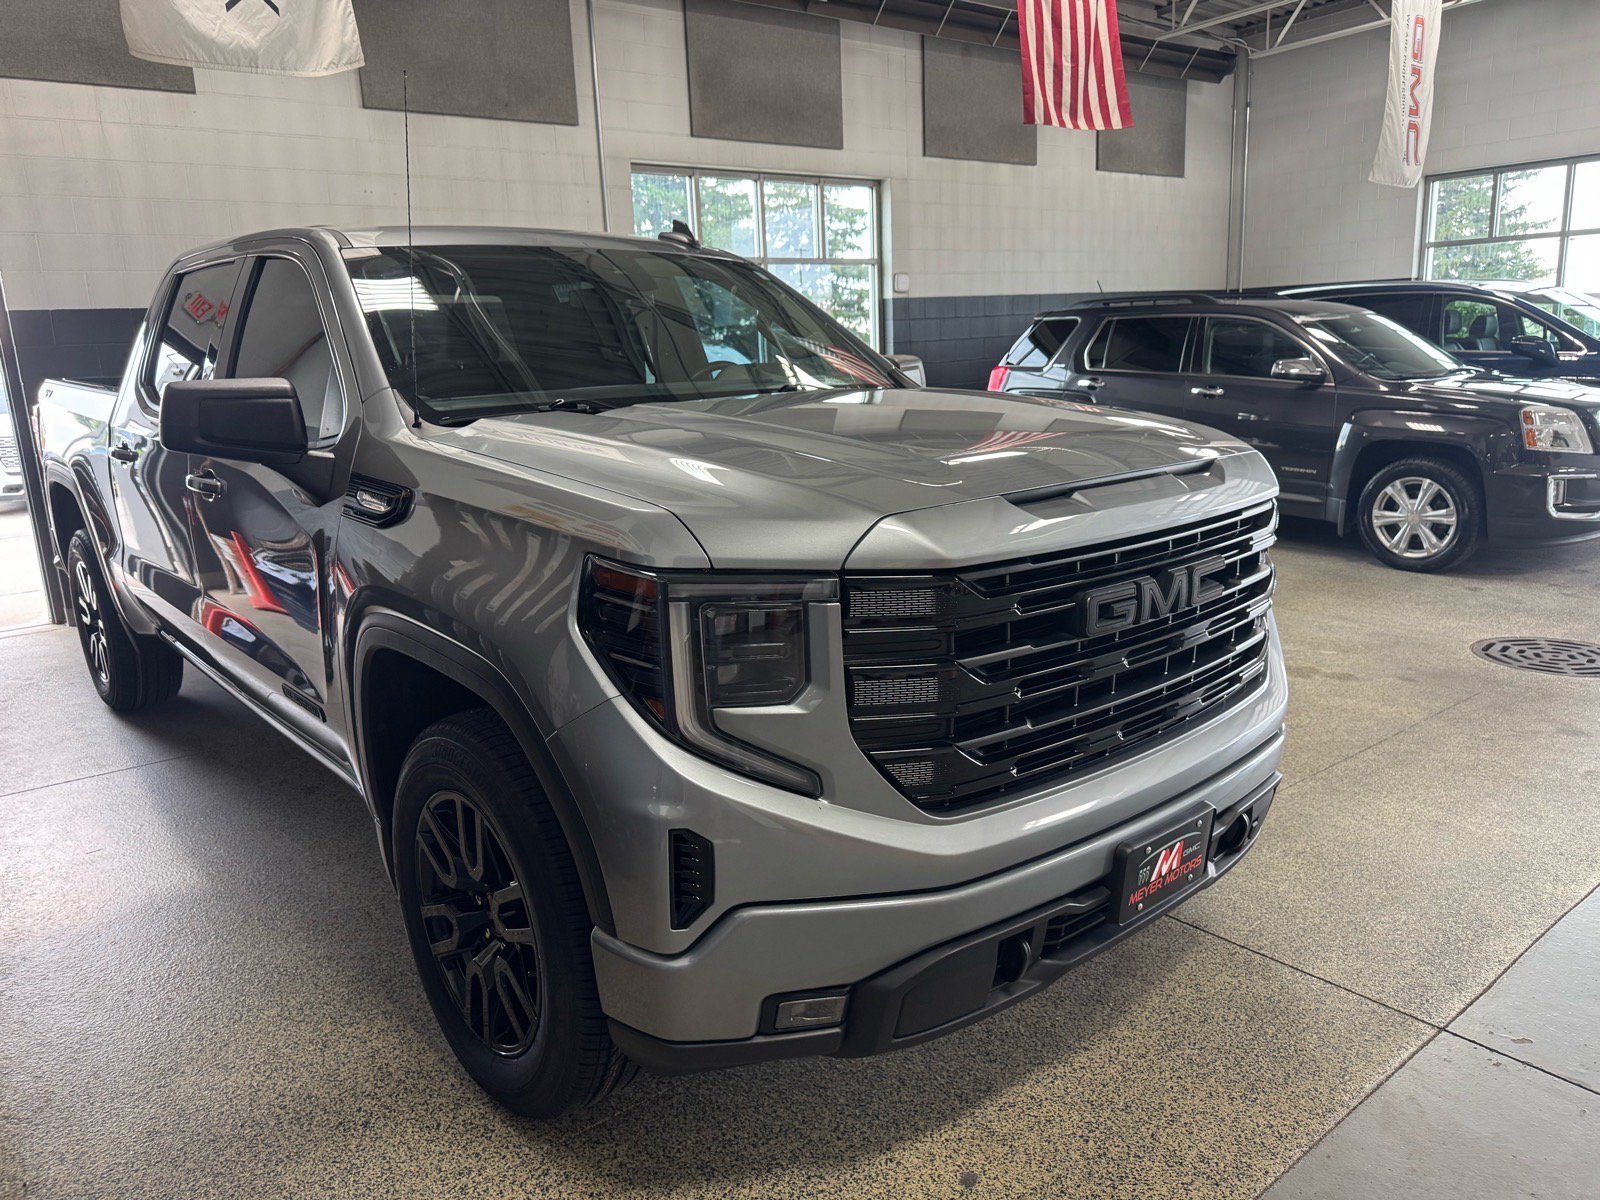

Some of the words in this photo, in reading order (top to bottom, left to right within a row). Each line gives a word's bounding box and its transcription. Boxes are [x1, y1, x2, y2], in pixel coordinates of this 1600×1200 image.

[1406, 15, 1424, 166] GMC
[1085, 554, 1226, 637] GMC
[1128, 878, 1162, 906] MEYER
[1164, 854, 1202, 886] MOTORS
[1183, 842, 1201, 857] GMC
